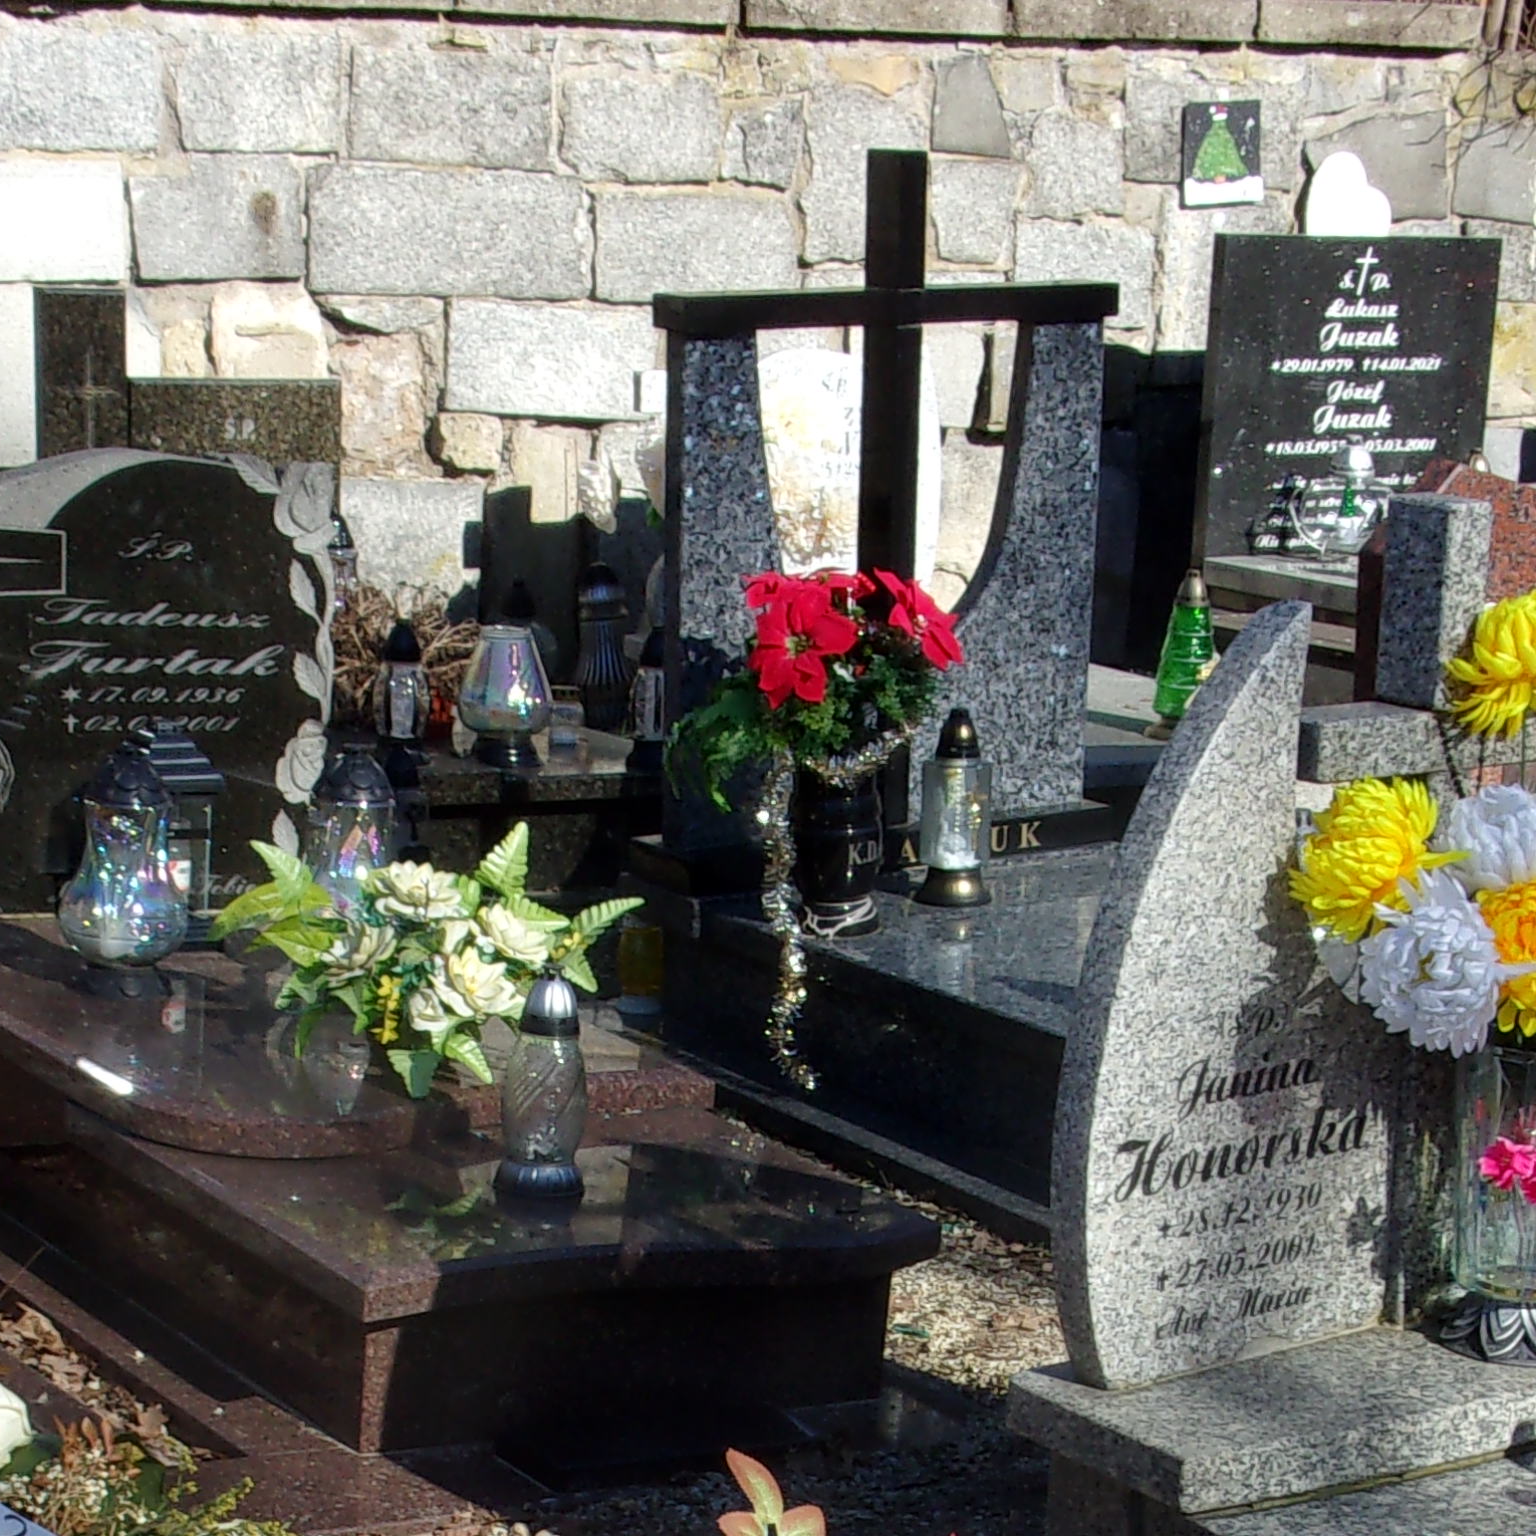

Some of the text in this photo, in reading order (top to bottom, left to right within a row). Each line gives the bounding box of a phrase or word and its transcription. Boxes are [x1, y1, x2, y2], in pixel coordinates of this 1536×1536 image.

[1320, 322, 1400, 352] Juzak
[1313, 404, 1393, 434] Juzak
[35, 597, 271, 629] Tadeusz
[19, 639, 285, 681] Furtak
[1175, 1051, 1320, 1123] Janina
[1112, 1104, 1371, 1203] Honorska
